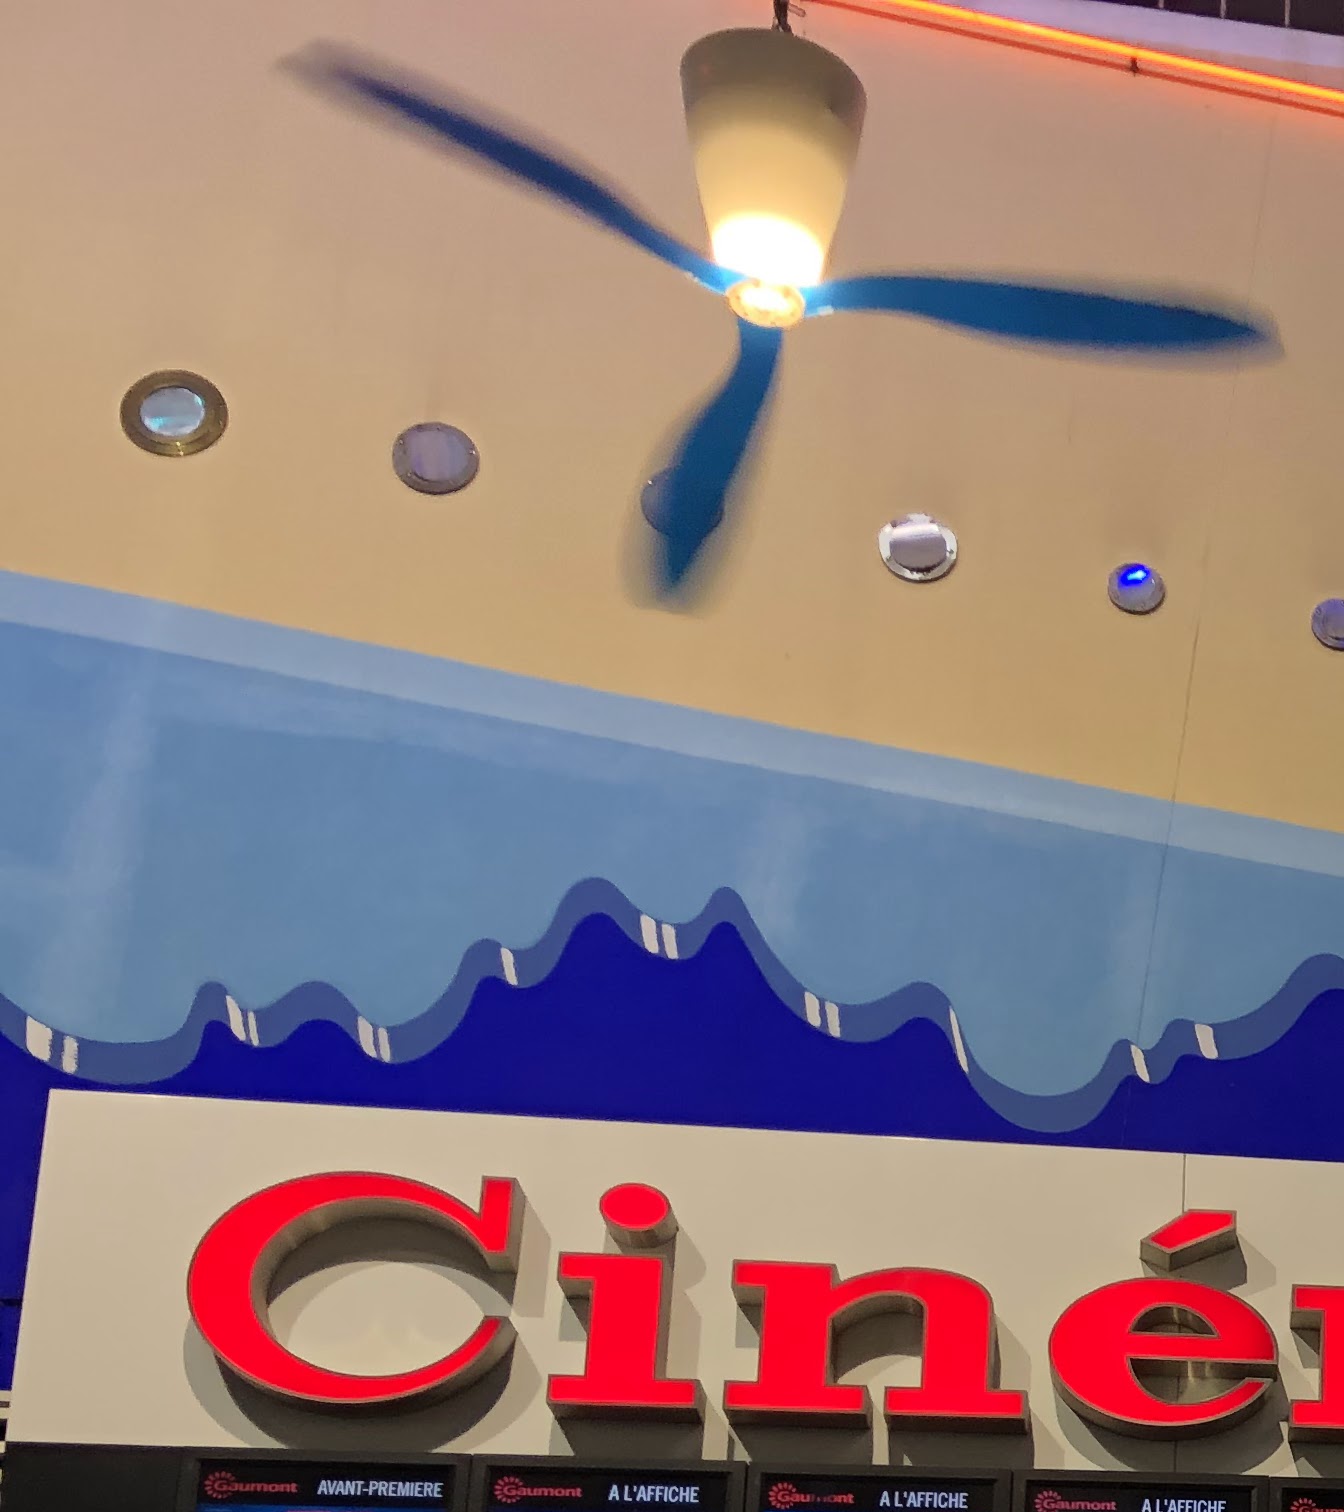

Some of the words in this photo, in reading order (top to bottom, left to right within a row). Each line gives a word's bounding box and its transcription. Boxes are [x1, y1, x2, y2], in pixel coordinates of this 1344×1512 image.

[213, 1481, 299, 1494] Gaumont
[317, 1479, 444, 1498] AVANT-PREMIERE
[502, 1484, 583, 1498] Gaumont
[608, 1484, 620, 1501] A
[624, 1485, 700, 1502] L'AFFICHE
[879, 1490, 891, 1507] A
[895, 1491, 969, 1509] L'AFFICHE
[1042, 1499, 1118, 1512] Gaumont
